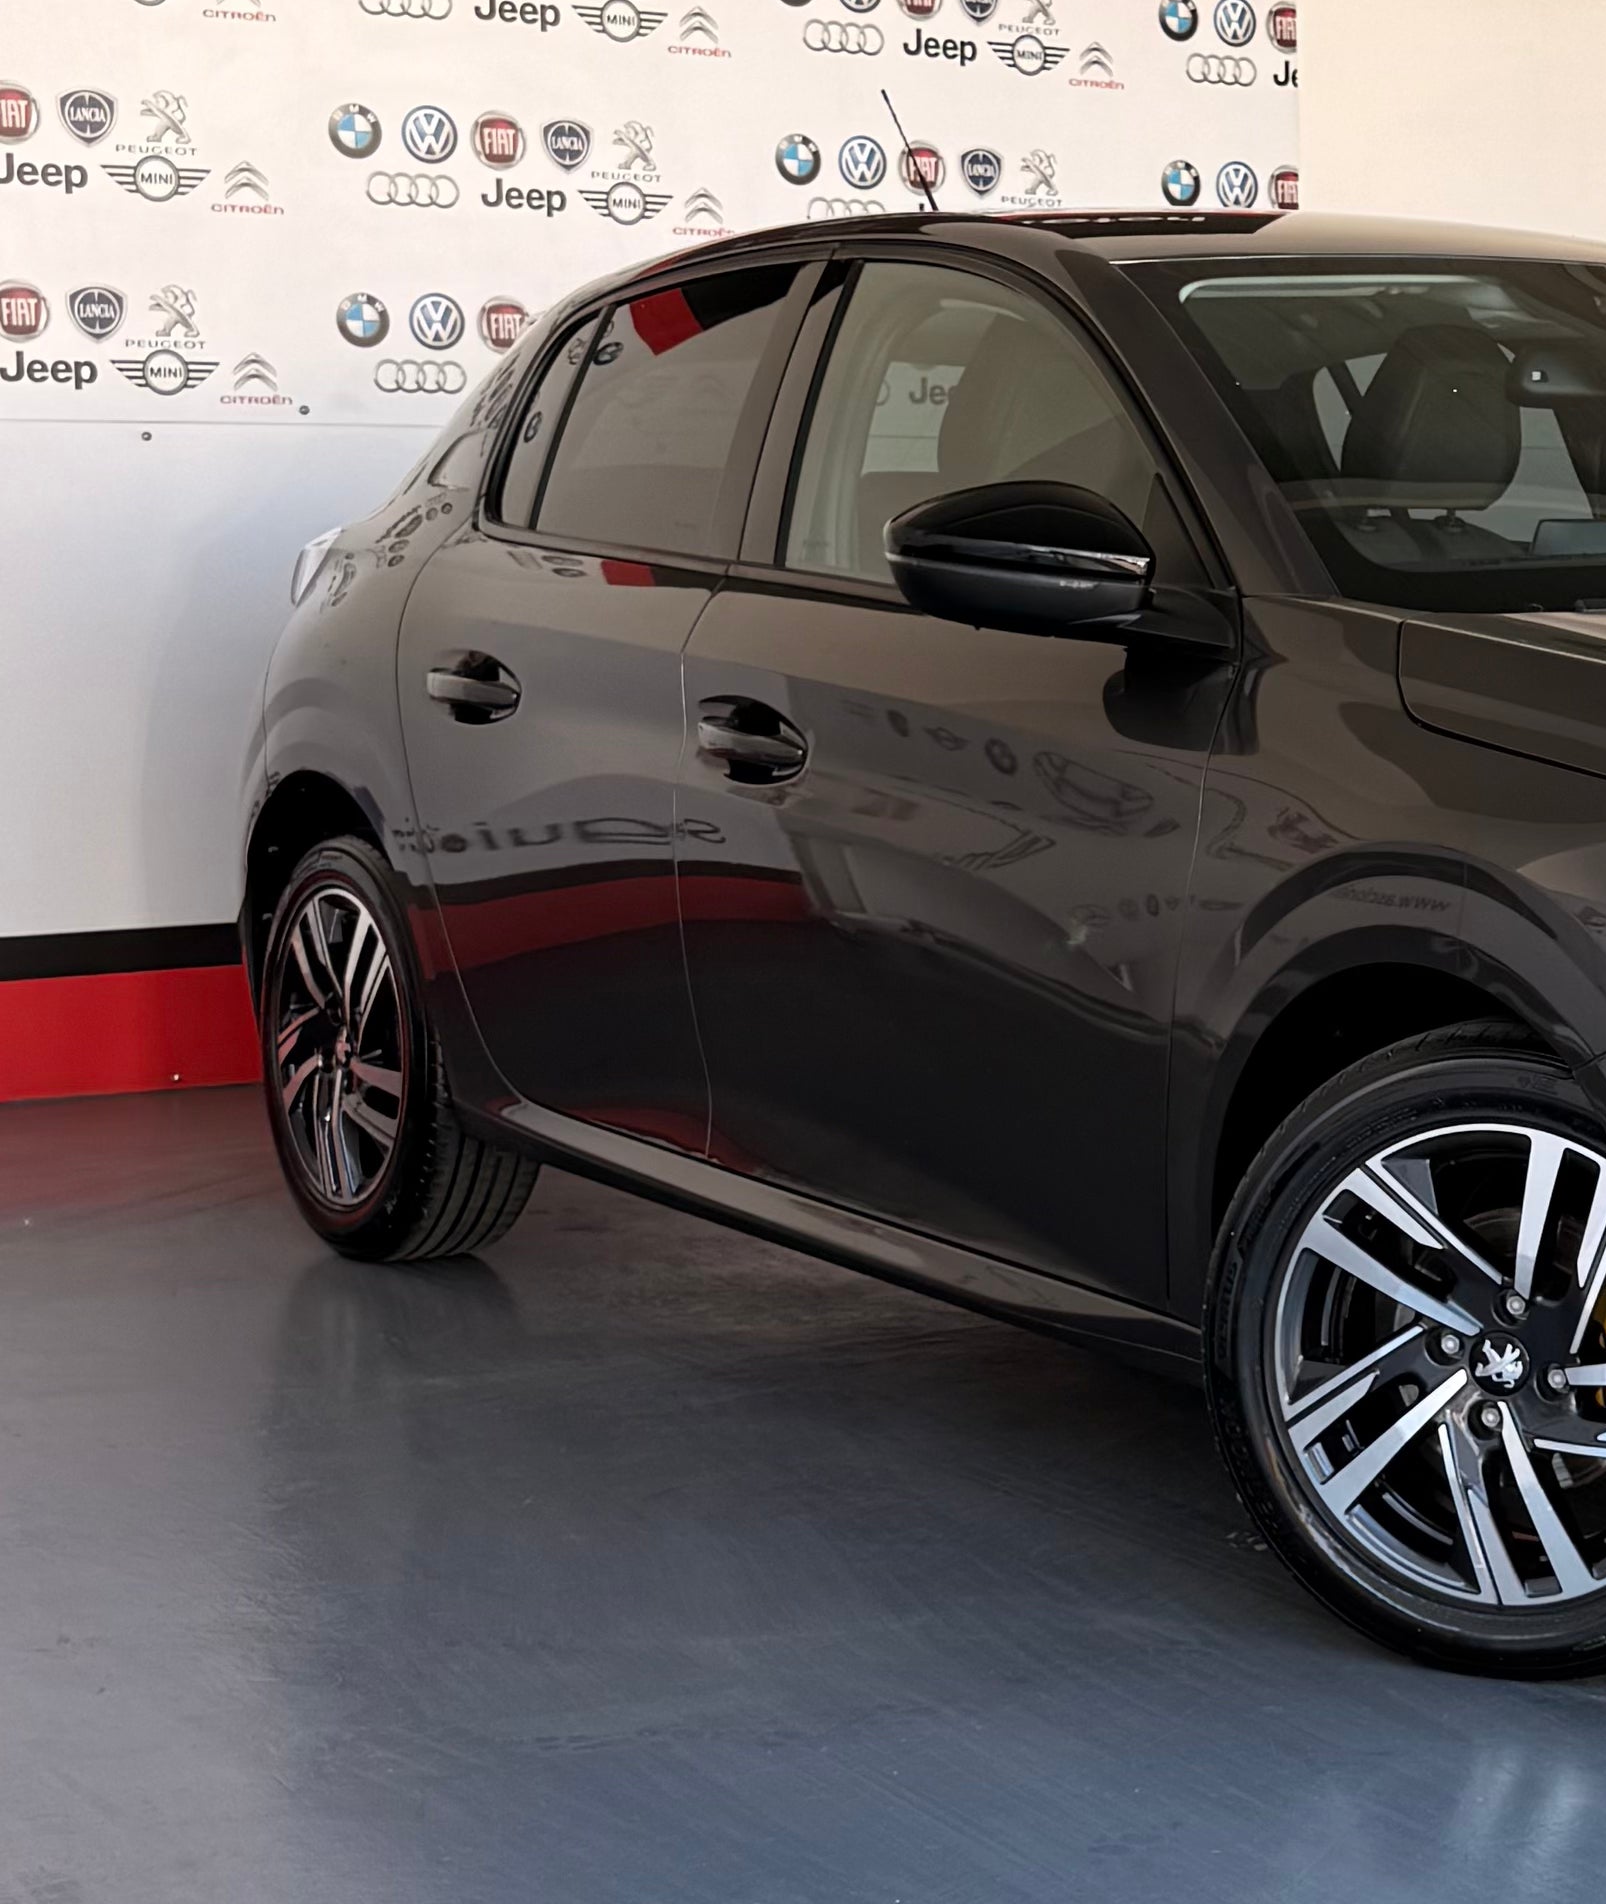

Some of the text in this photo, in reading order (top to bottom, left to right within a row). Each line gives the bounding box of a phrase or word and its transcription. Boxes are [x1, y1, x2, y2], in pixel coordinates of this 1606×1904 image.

[606, 13, 636, 27] MINI
[998, 23, 1061, 37] PEUGEOT
[903, 28, 977, 66] Jeep
[1015, 49, 1043, 62] MINI
[0, 99, 29, 129] IAT
[70, 106, 107, 123] LANCIA
[115, 143, 197, 157] PEUGEOT
[483, 128, 516, 156] FIAT
[551, 135, 584, 153] LANCIA
[140, 172, 174, 185] MINI
[591, 170, 661, 184] PEUGEOT
[481, 178, 567, 218] Jeep
[612, 196, 642, 210] MINI
[1001, 195, 1063, 208] PEUGEOT
[1, 297, 38, 327] FIAT
[79, 302, 116, 320] LANCIA
[490, 312, 523, 340] FIAT
[125, 338, 207, 351] PEUGEOT
[0, 350, 98, 390] Jeep
[149, 366, 183, 379] MINI
[908, 375, 950, 406] Je
